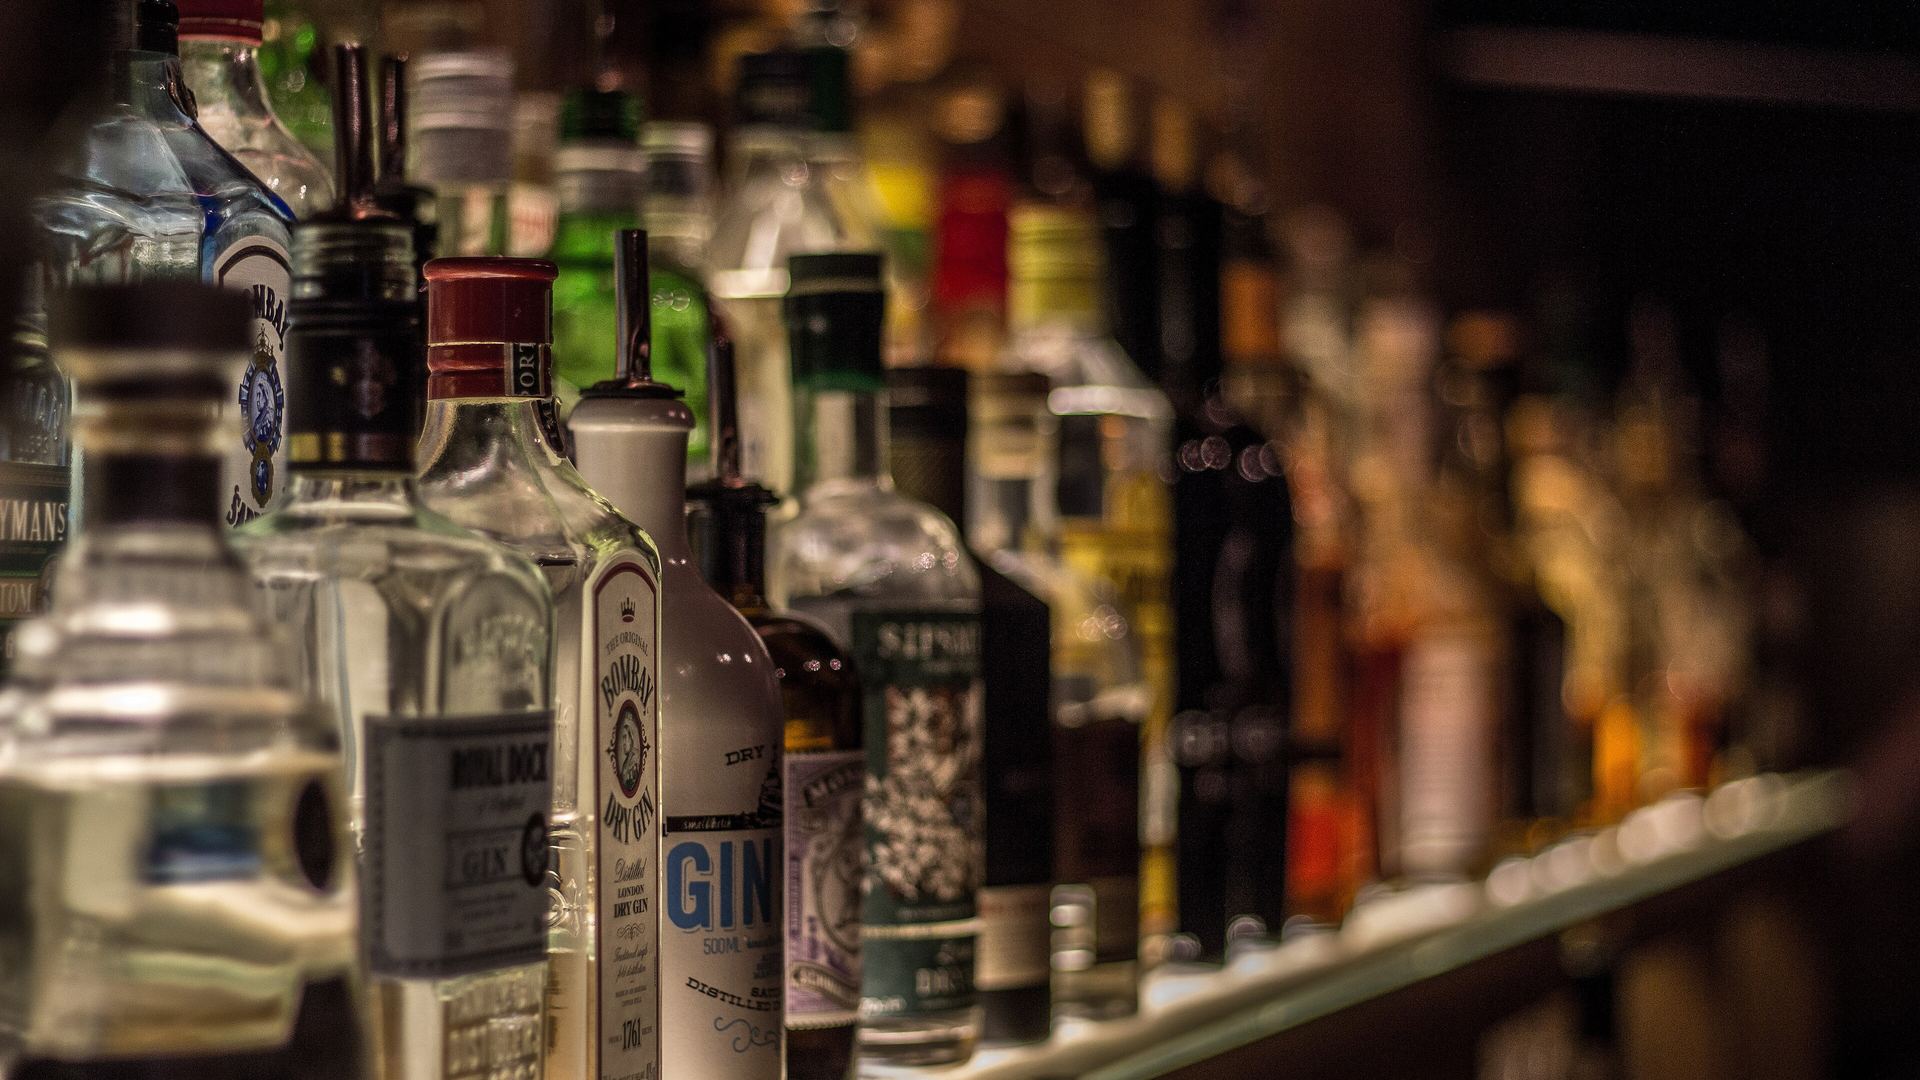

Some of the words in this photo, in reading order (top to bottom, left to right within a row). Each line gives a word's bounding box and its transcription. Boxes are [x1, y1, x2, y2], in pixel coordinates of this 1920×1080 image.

[606, 634, 620, 656] THE
[620, 631, 649, 657] ORIGINAL
[601, 653, 654, 717] BOMBAY
[724, 746, 765, 766] DRY
[604, 790, 632, 845] DRY
[632, 784, 654, 841] GIN
[461, 847, 508, 885] GIN
[613, 857, 647, 883] Distilled
[617, 884, 645, 898] LONDON
[667, 838, 775, 933] GIN
[613, 901, 632, 918] DRY
[633, 898, 648, 914] GIN
[703, 936, 741, 955] 500ML
[685, 976, 772, 1012] DISTILLED
[622, 1016, 641, 1052] 1761
